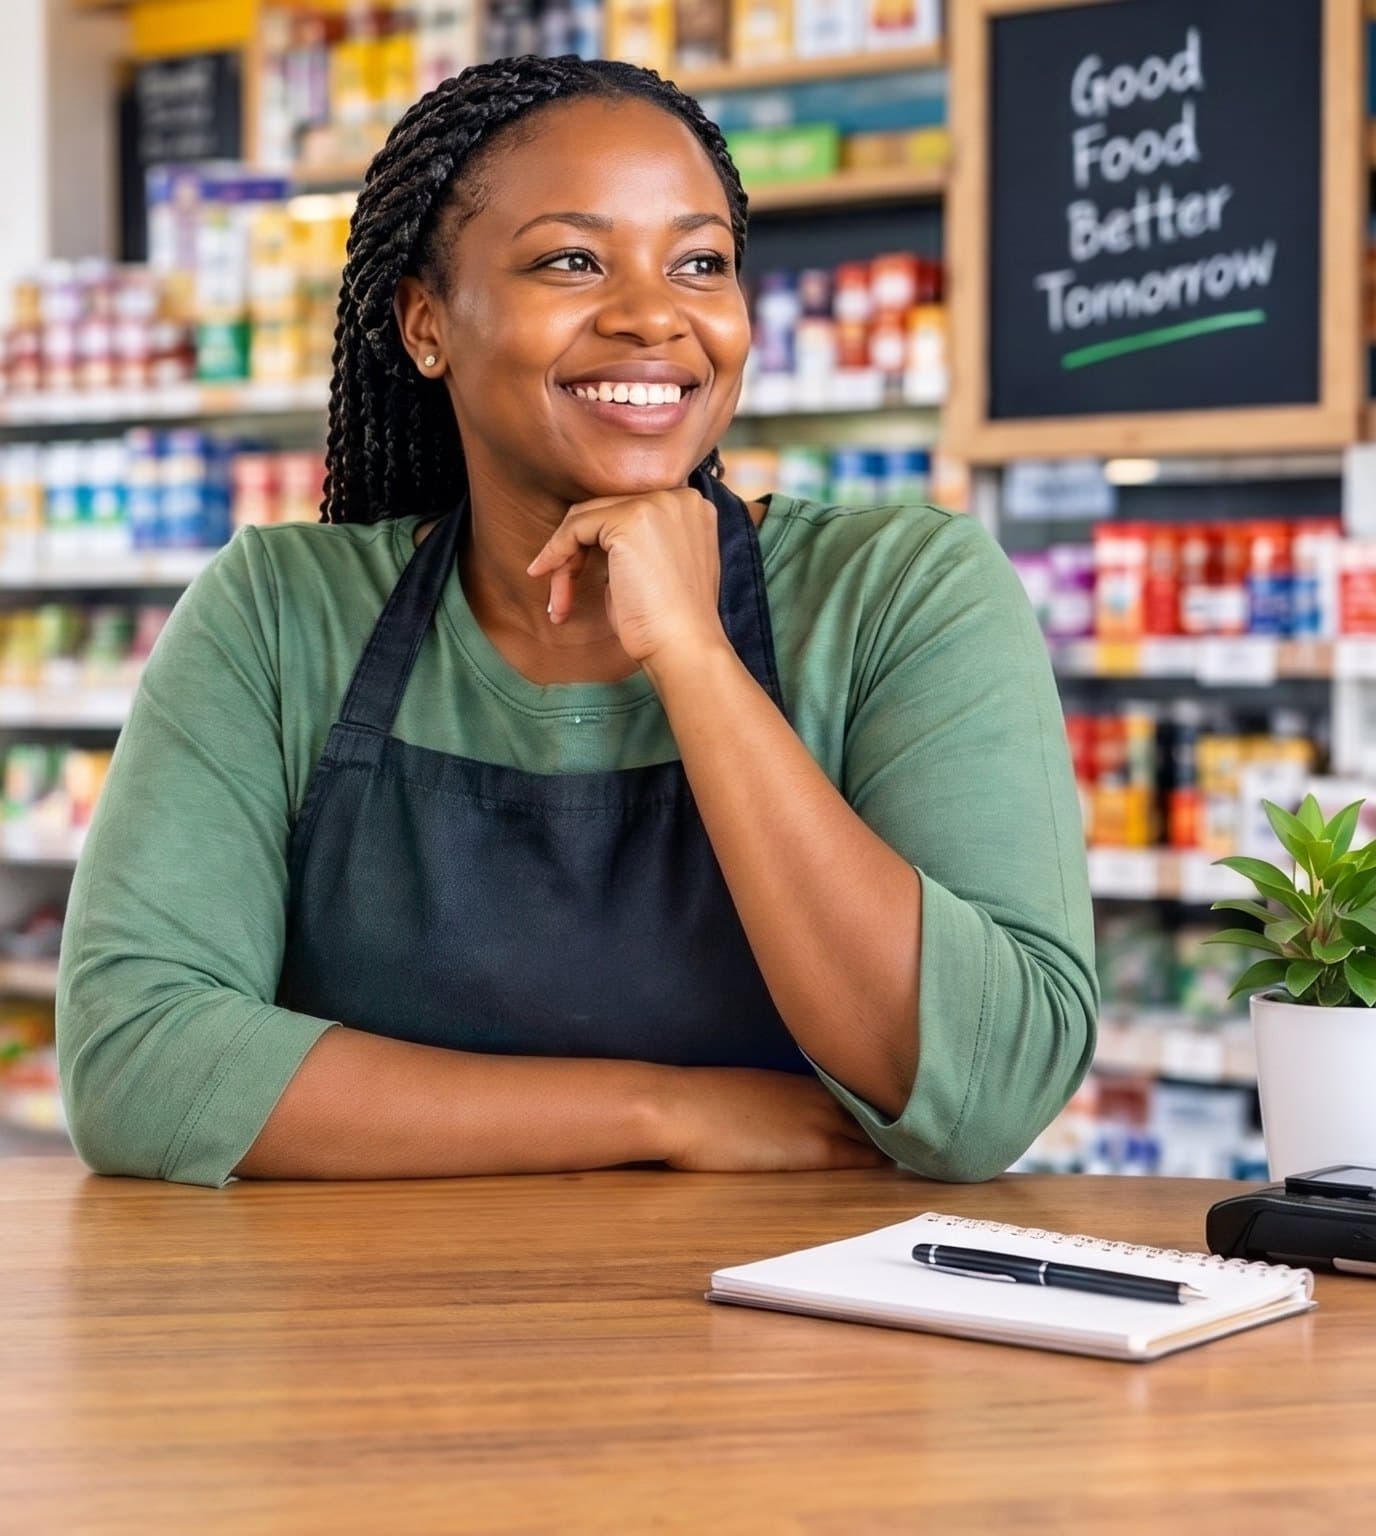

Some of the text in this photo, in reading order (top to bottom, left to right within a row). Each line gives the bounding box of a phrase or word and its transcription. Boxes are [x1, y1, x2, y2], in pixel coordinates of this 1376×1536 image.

[1071, 25, 1203, 117] Good
[1072, 98, 1199, 187] Food
[1066, 183, 1233, 261] Better
[1034, 239, 1276, 333] Tomorrow
